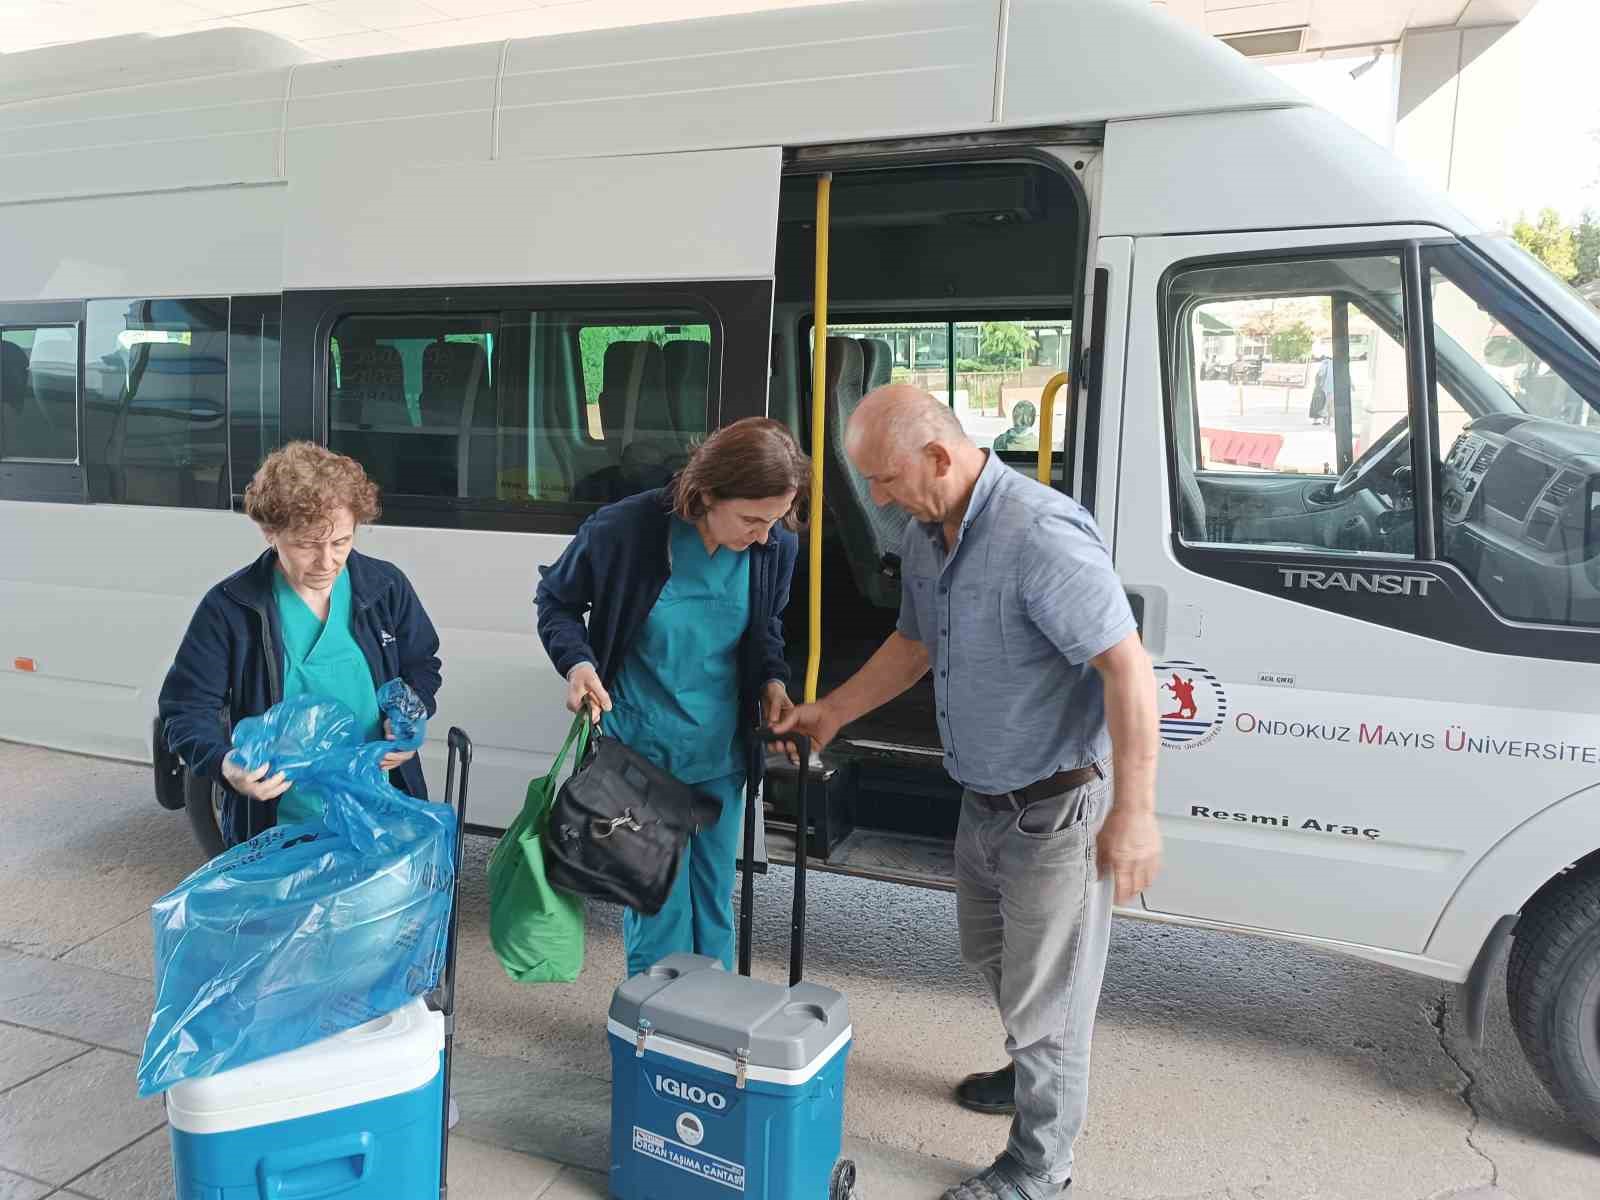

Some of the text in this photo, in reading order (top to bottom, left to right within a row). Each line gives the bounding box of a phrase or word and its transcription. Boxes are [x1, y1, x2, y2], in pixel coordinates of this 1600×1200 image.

[1278, 568, 1437, 596] TRANSIT
[1235, 712, 1600, 764] ONDOKUZ MAYIS ÜNİVERSİTE
[1191, 805, 1381, 840] Resmi Araç
[655, 1074, 727, 1111] IGLOO
[636, 1138, 668, 1158] ORGAN
